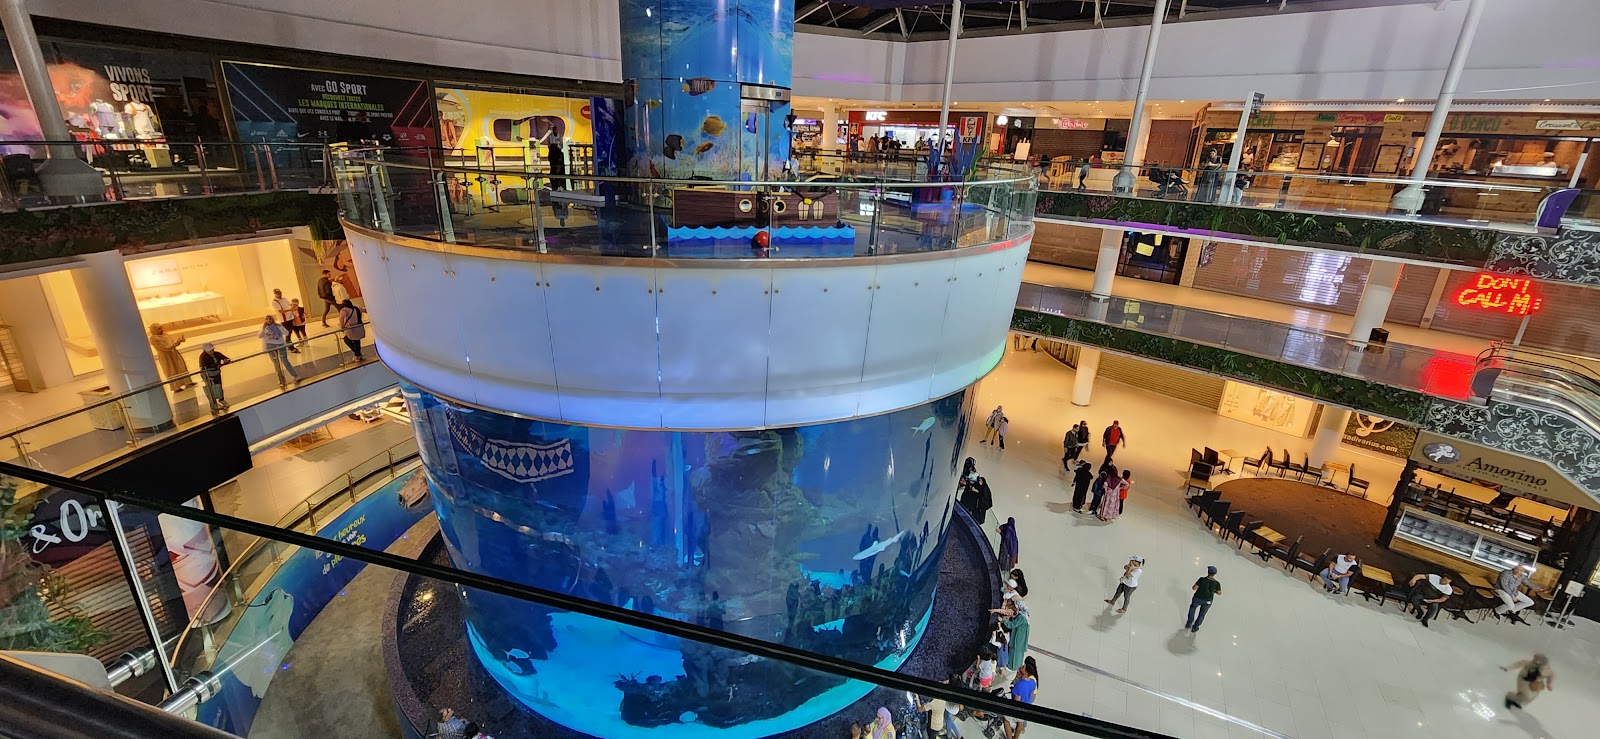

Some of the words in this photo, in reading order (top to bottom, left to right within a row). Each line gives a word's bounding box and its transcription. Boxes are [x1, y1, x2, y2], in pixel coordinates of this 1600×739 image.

[104, 65, 150, 83] VIVONS
[110, 83, 154, 102] SPORT
[311, 83, 325, 92] AVEC
[326, 80, 338, 93] GO
[340, 82, 366, 95] SPORT
[298, 99, 309, 107] LES
[311, 100, 337, 109] MARQUES
[339, 102, 384, 111] INTERNATIONALES
[865, 111, 888, 121] KFC
[1458, 288, 1508, 308] CALL
[1343, 434, 1398, 453] radivarius.com
[1466, 457, 1547, 487] Amorino
[31, 524, 61, 553] &
[331, 553, 343, 569] plu
[351, 534, 367, 546] rès
